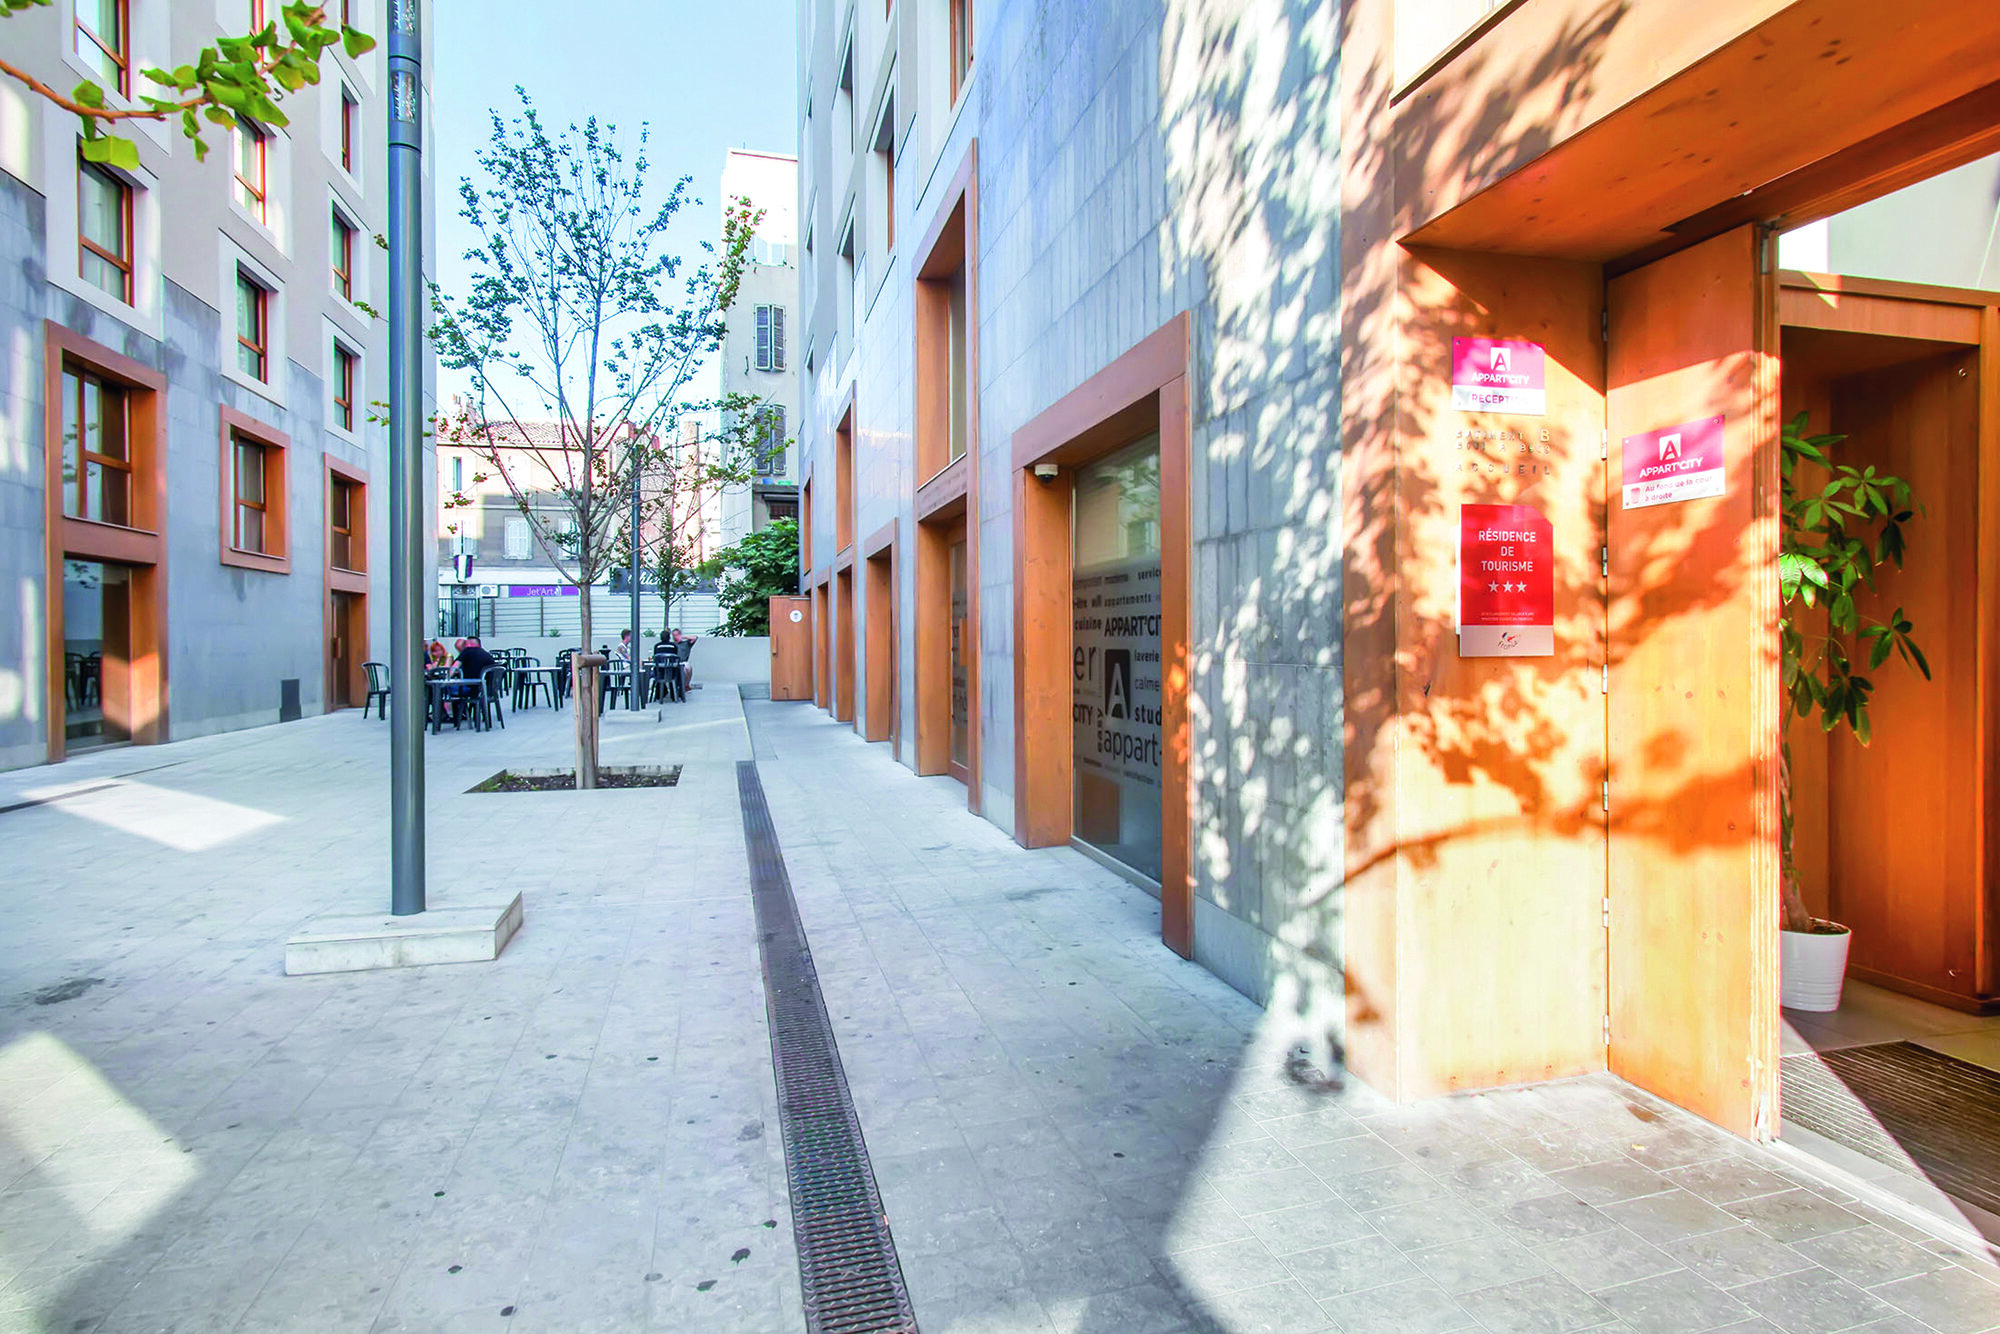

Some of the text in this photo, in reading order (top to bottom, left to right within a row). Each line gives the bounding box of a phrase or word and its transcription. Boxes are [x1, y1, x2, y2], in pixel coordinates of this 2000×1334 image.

[1471, 393, 1528, 405] RECEPT
[1639, 456, 1704, 478] APPART'CITY
[1478, 528, 1537, 543] RÉSIDENCE
[1500, 546, 1515, 557] DE
[1480, 561, 1534, 572] TOURISME
[1134, 649, 1160, 662] laverie
[1104, 649, 1131, 719] A
[1134, 676, 1160, 692] calme
